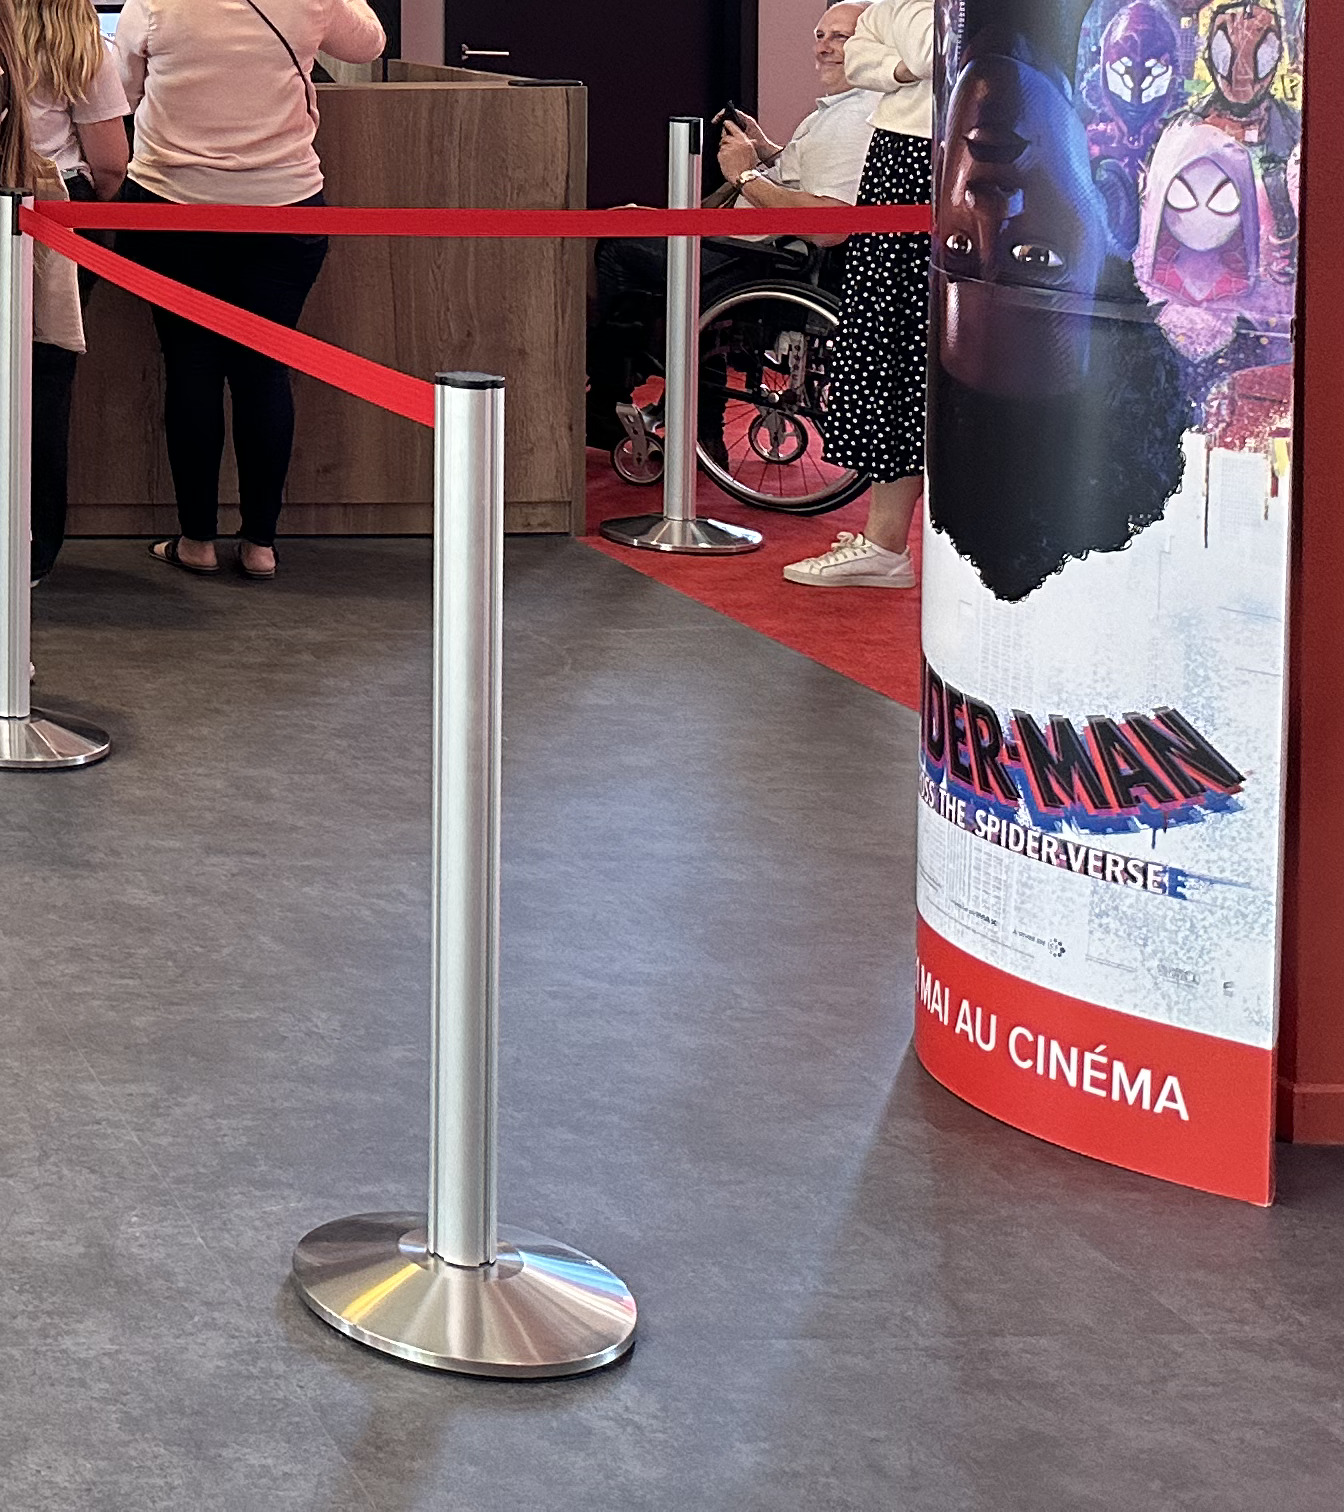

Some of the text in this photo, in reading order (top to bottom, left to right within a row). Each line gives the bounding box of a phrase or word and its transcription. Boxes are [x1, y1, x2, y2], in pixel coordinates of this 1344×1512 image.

[938, 787, 966, 829] THE
[920, 964, 950, 1026] MAI
[955, 998, 998, 1052] AU
[1008, 1025, 1190, 1121] CINÉMA
